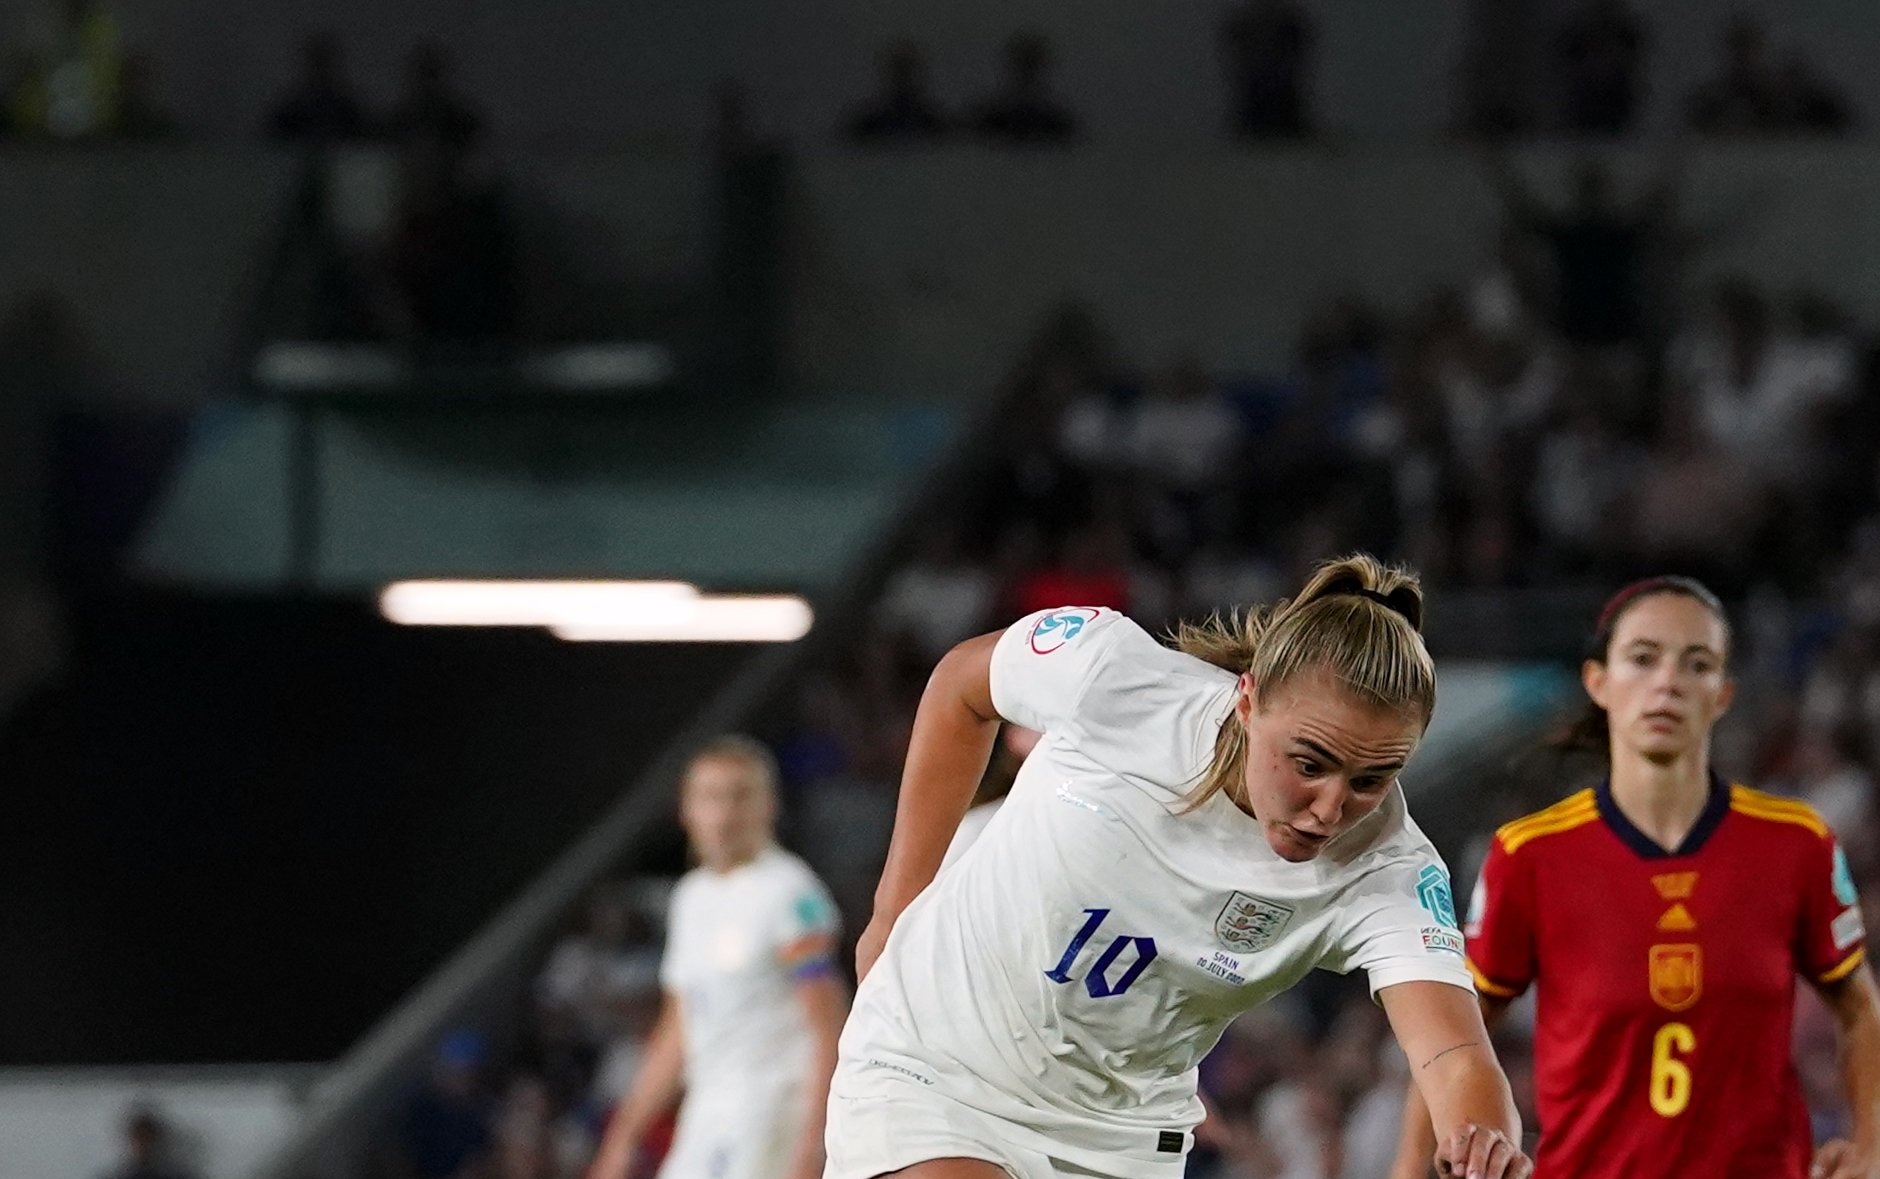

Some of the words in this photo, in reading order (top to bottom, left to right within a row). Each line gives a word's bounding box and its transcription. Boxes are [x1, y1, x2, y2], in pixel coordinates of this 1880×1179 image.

[1422, 935, 1463, 951] FOUN
[1043, 908, 1158, 999] 10
[1213, 951, 1240, 971] SPAIN
[1206, 961, 1229, 978] JULY
[1649, 1022, 1697, 1119] 6
